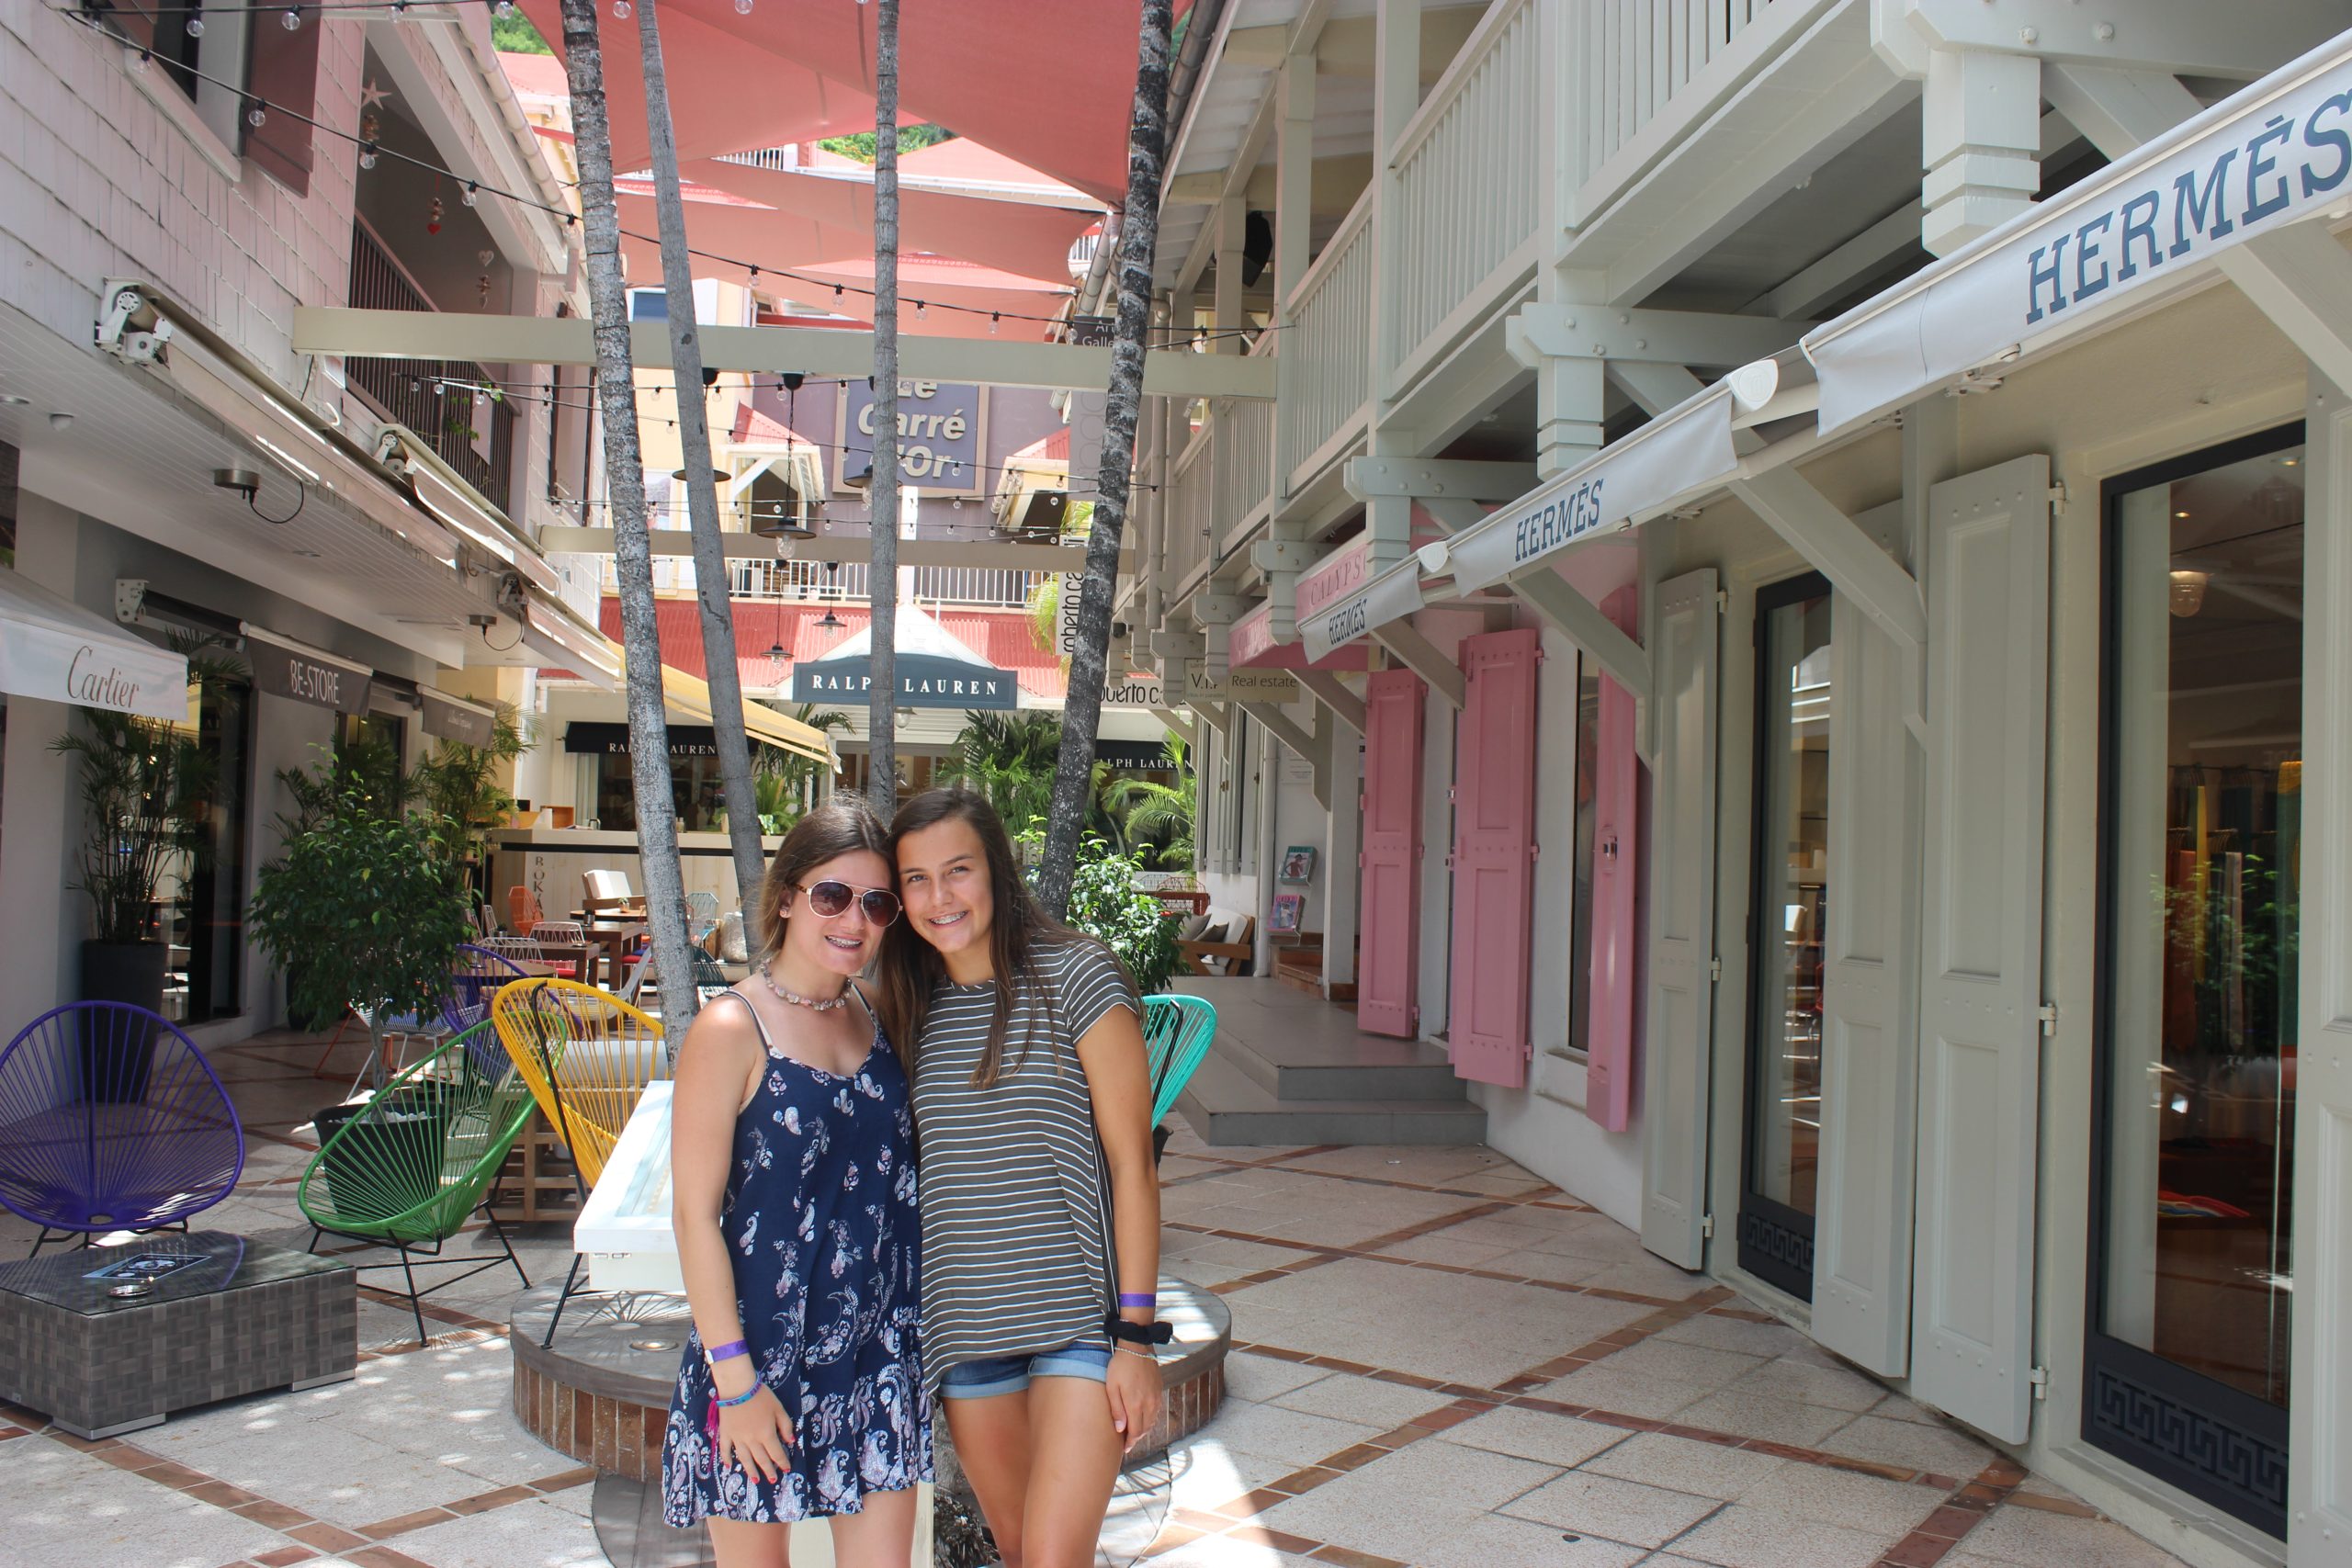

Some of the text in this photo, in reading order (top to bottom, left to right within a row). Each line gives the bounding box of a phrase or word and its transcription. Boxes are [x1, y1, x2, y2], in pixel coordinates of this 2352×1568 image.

[1081, 335, 1114, 347] Galle
[1310, 553, 1366, 606] CALYPS
[68, 645, 140, 708] Cartier
[290, 659, 340, 705] BE-STORE
[812, 674, 997, 694] RALP LAUREN
[1232, 675, 1297, 688] Real estate
[670, 744, 717, 754] AUREN
[1100, 759, 1193, 769] LPH LAURN
